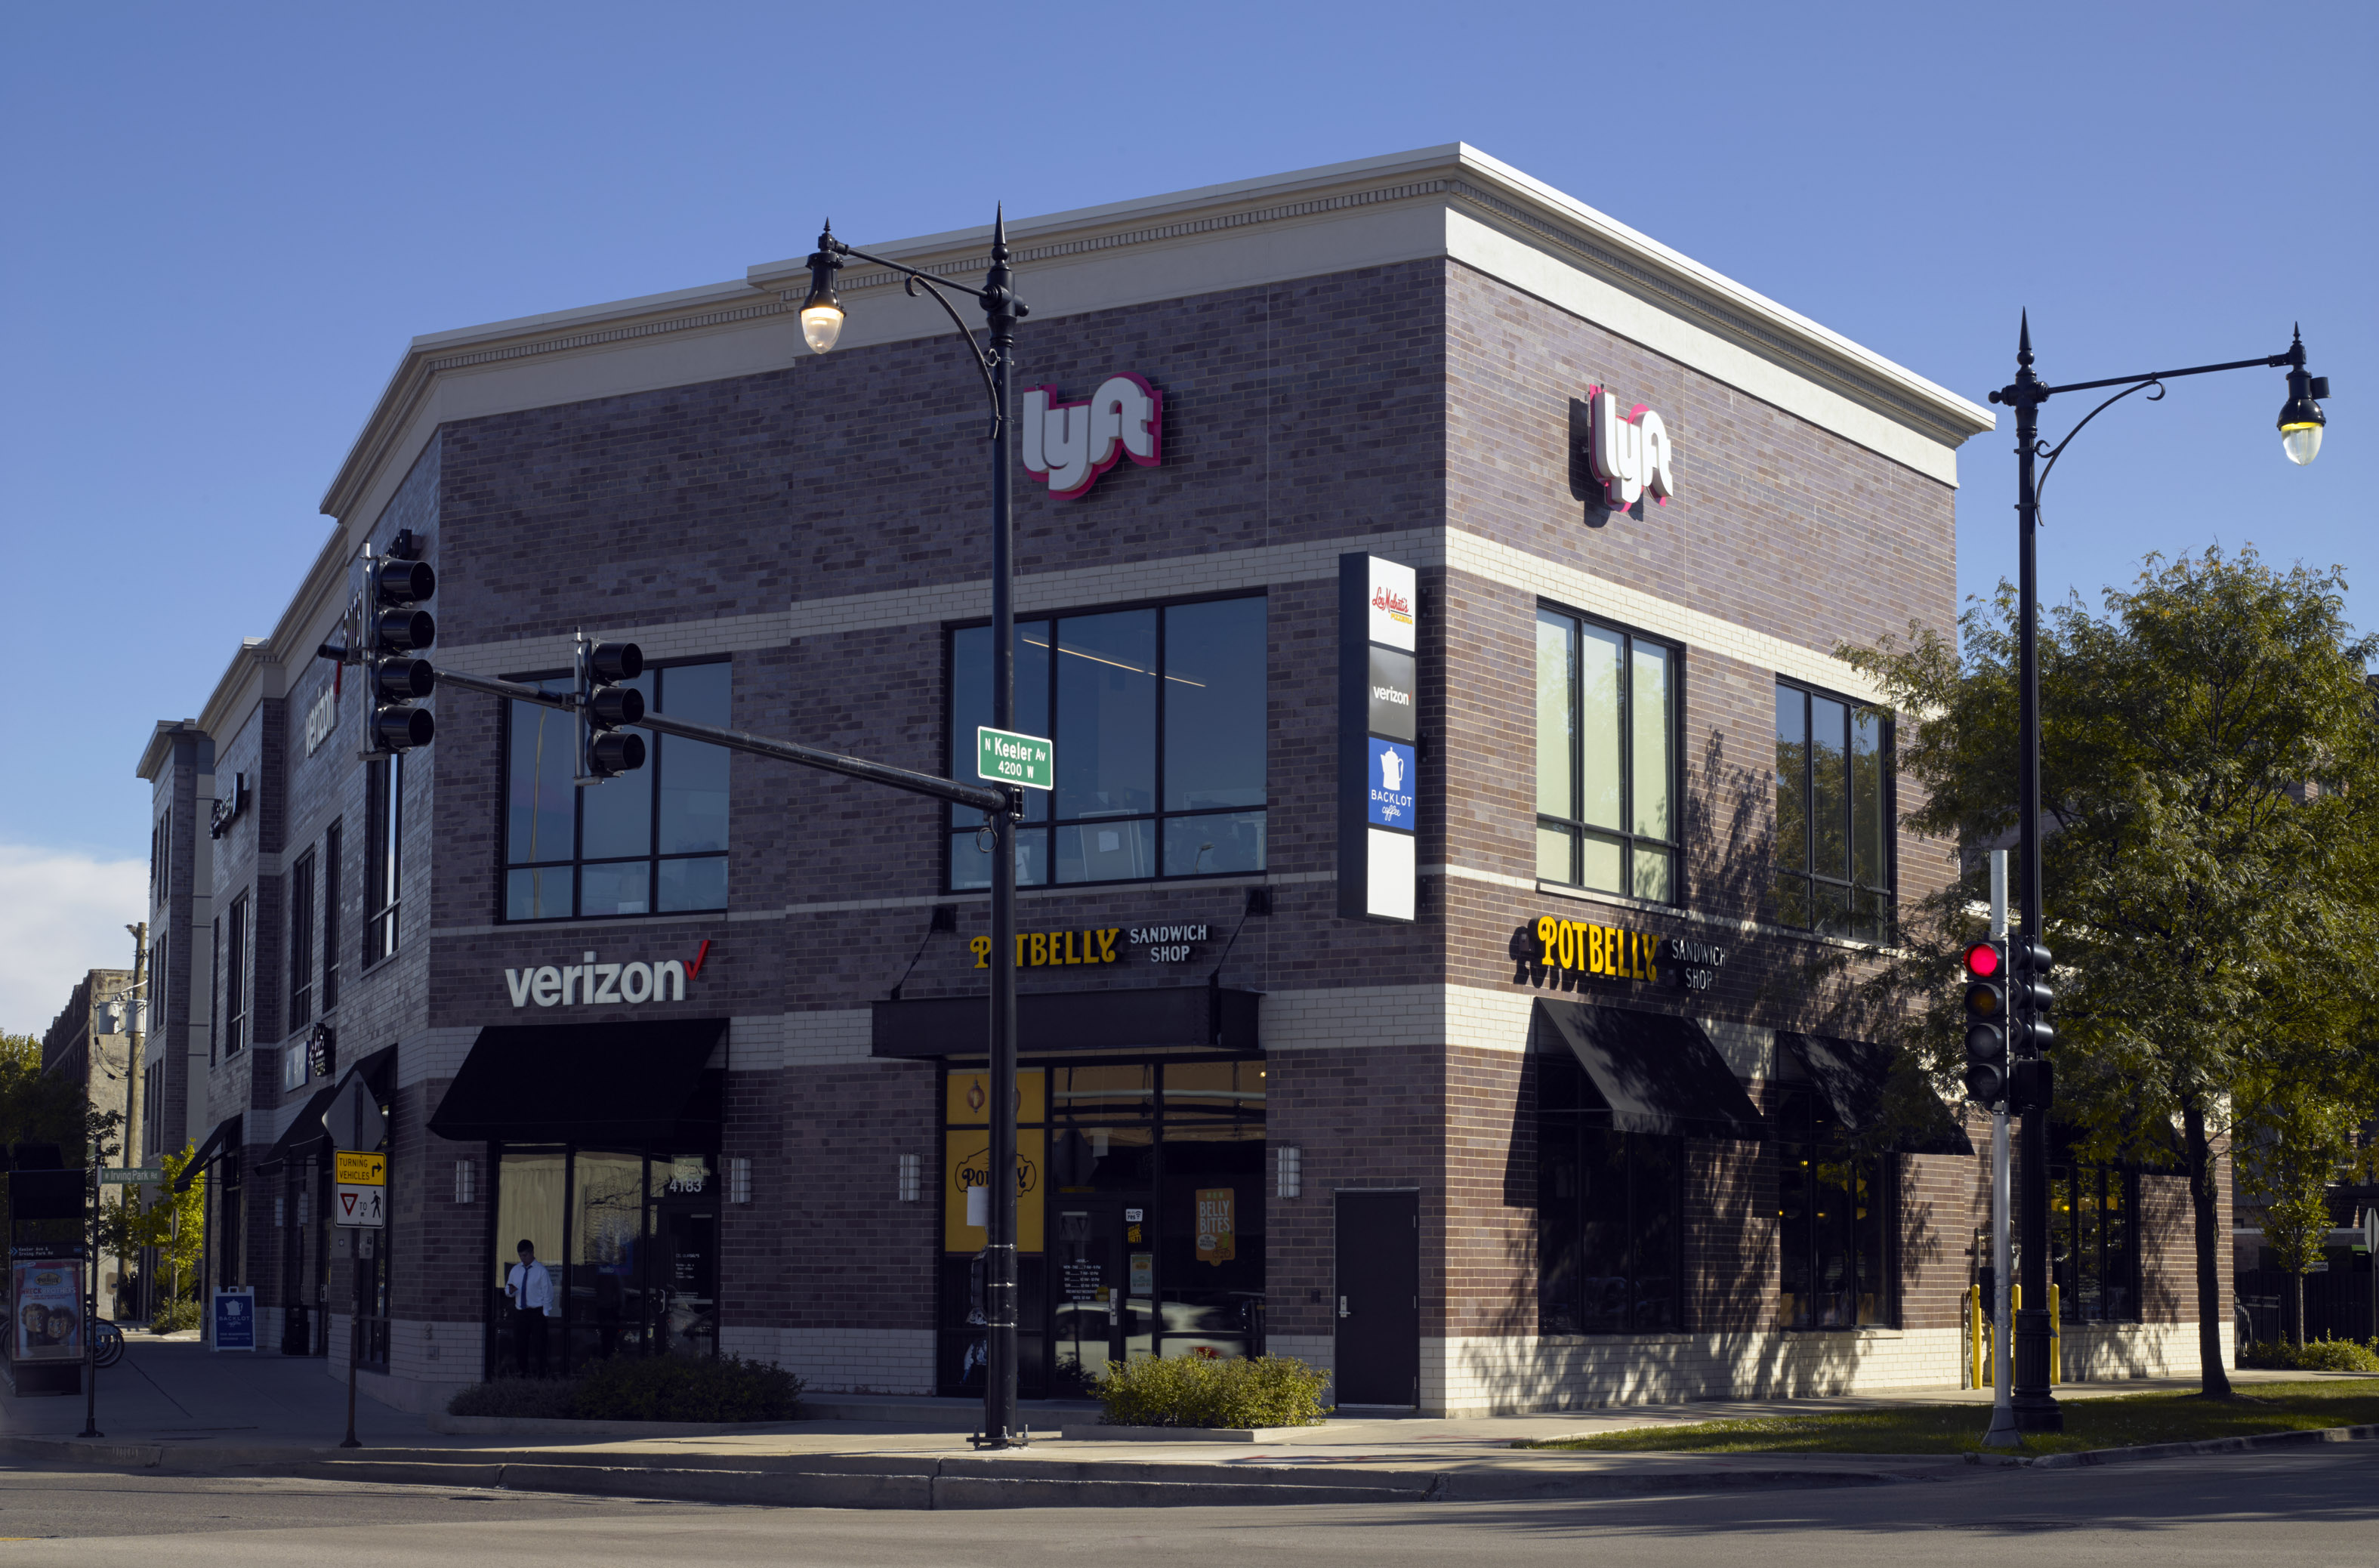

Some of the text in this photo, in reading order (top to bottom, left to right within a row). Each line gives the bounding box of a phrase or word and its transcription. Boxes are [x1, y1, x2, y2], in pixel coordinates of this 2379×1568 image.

[1023, 375, 1159, 495] lyft
[1592, 389, 1674, 506] lyft
[1372, 586, 1387, 611] Lou
[1390, 612, 1413, 625] PIZZERIA
[1373, 685, 1409, 706] verizon
[985, 736, 1045, 762] N Keeler Av
[998, 760, 1034, 779] 4200 W
[1371, 789, 1412, 807] BACKLOT
[1381, 805, 1401, 822] coffee
[970, 924, 1208, 969] PTBELLY SANDWICH
[1150, 946, 1190, 963] SHOP
[1538, 915, 1726, 983] POTBELLY SANDWICH
[504, 950, 686, 1008] verizon
[1685, 970, 1713, 991] SHOP
[339, 1157, 368, 1168] TURNING
[676, 1165, 702, 1174] OPEN
[111, 1171, 131, 1183] Irving
[132, 1170, 149, 1181] Park
[339, 1170, 370, 1181] VEHICLES
[669, 1178, 702, 1193] 4183
[359, 1202, 368, 1211] TO
[1199, 1200, 1230, 1217] BELLY
[1199, 1218, 1230, 1233] BITES
